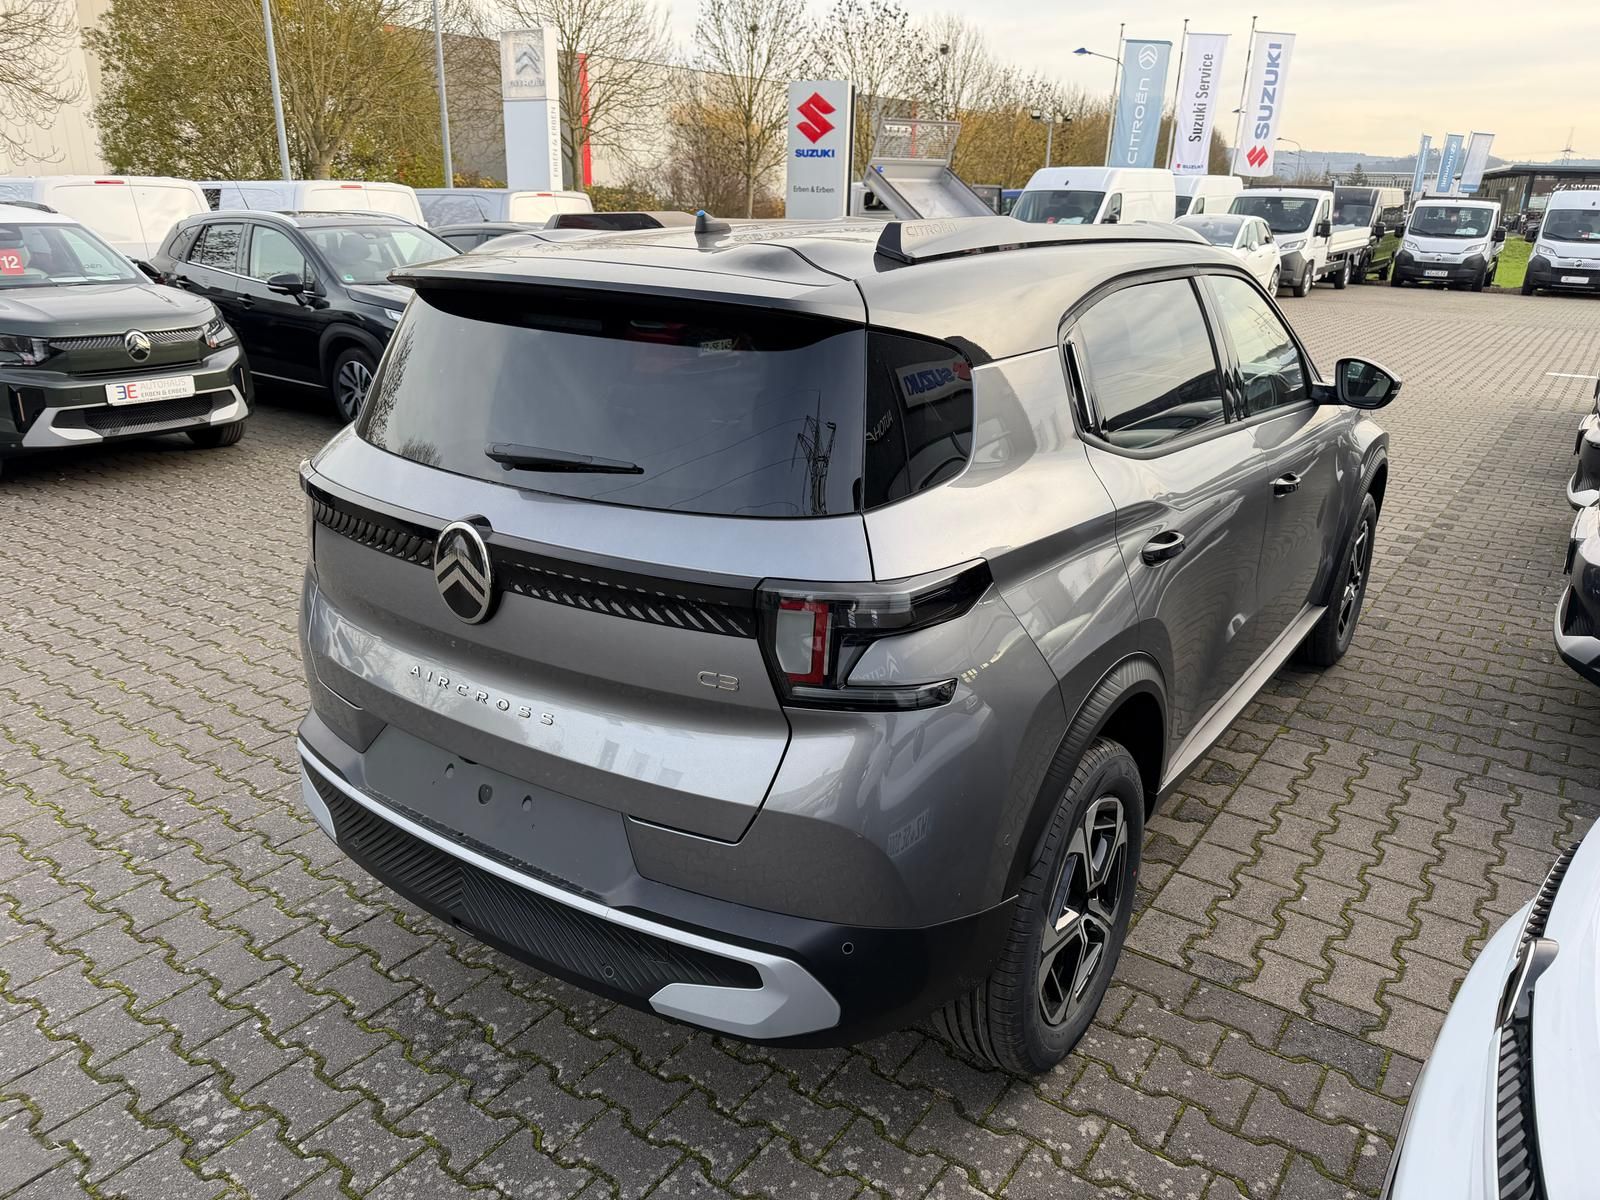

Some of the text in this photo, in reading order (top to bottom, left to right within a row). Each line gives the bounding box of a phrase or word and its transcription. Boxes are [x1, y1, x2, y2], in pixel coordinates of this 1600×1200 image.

[1188, 53, 1214, 143] Suzuki Service
[1254, 43, 1282, 140] SUZUKI
[1127, 77, 1150, 164] CITROËN
[795, 149, 835, 158] SUZUKI
[793, 185, 809, 193] Erben
[1, 255, 20, 269] 12
[139, 379, 187, 391] AUTOHAUS
[141, 390, 161, 398] ERBEN
[168, 387, 187, 395] ERBEN
[697, 670, 740, 692] C3
[410, 665, 554, 726] AIRCROSS
